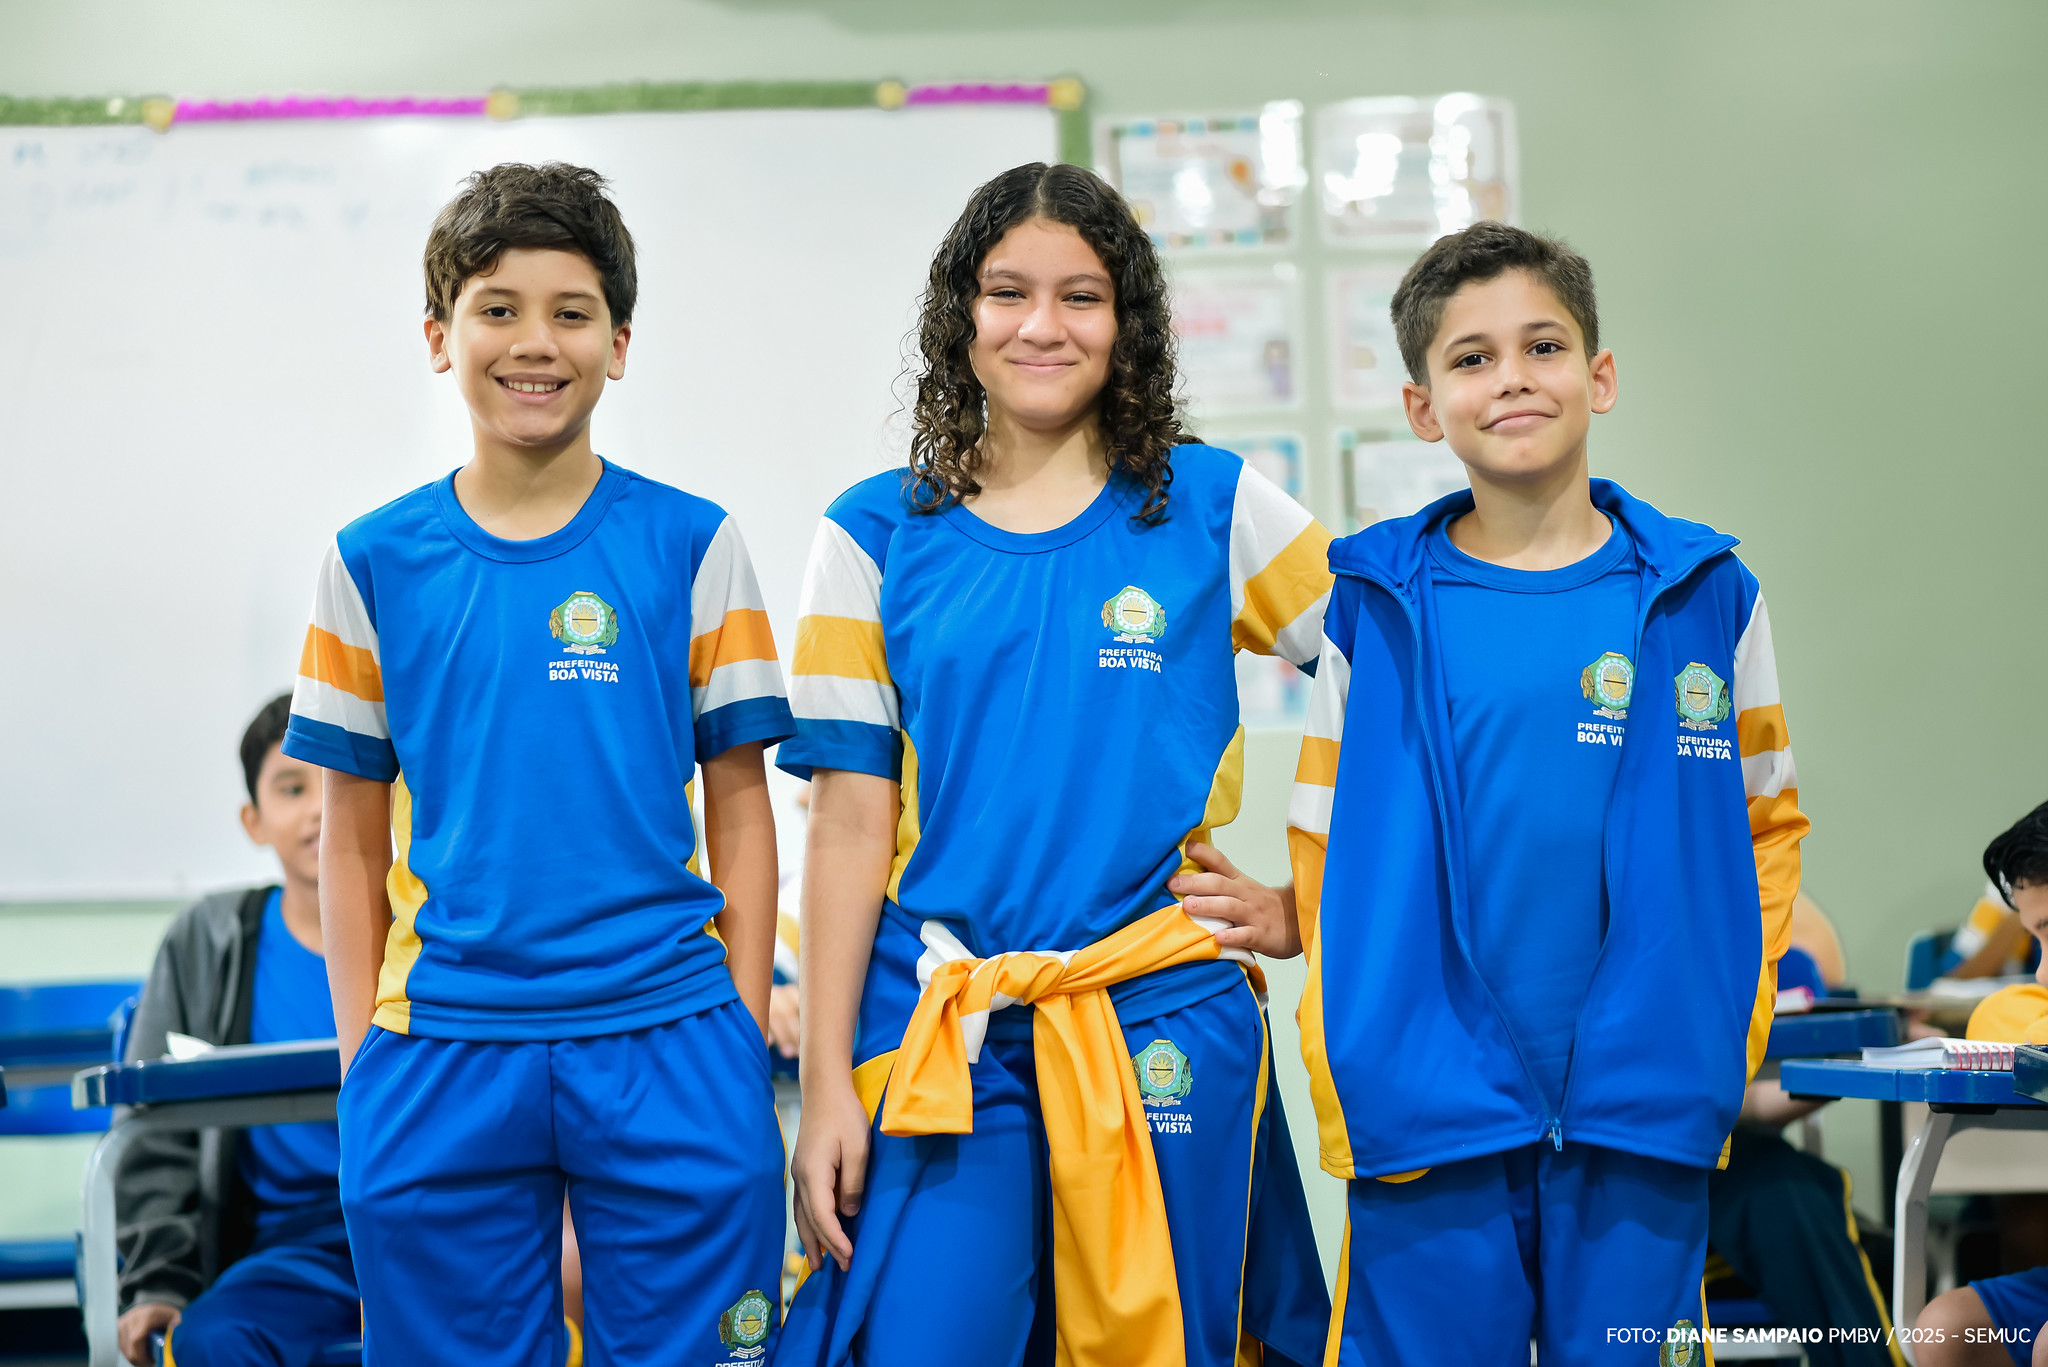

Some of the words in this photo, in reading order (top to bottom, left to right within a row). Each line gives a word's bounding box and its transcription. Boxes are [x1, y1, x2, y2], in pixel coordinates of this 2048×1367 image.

[1099, 649, 1162, 662] PREFEITURA
[549, 660, 619, 671] PREFEITURA
[1099, 657, 1127, 668] BOA
[1130, 657, 1161, 673] VISTA
[549, 669, 578, 681] BOA
[581, 668, 618, 683] VISTA
[1577, 722, 1625, 734] PREFEIT
[1577, 731, 1606, 744] BOA
[1695, 745, 1732, 760] VISTA
[1146, 1113, 1192, 1122] FEITURA
[1156, 1121, 1192, 1133] VISTA
